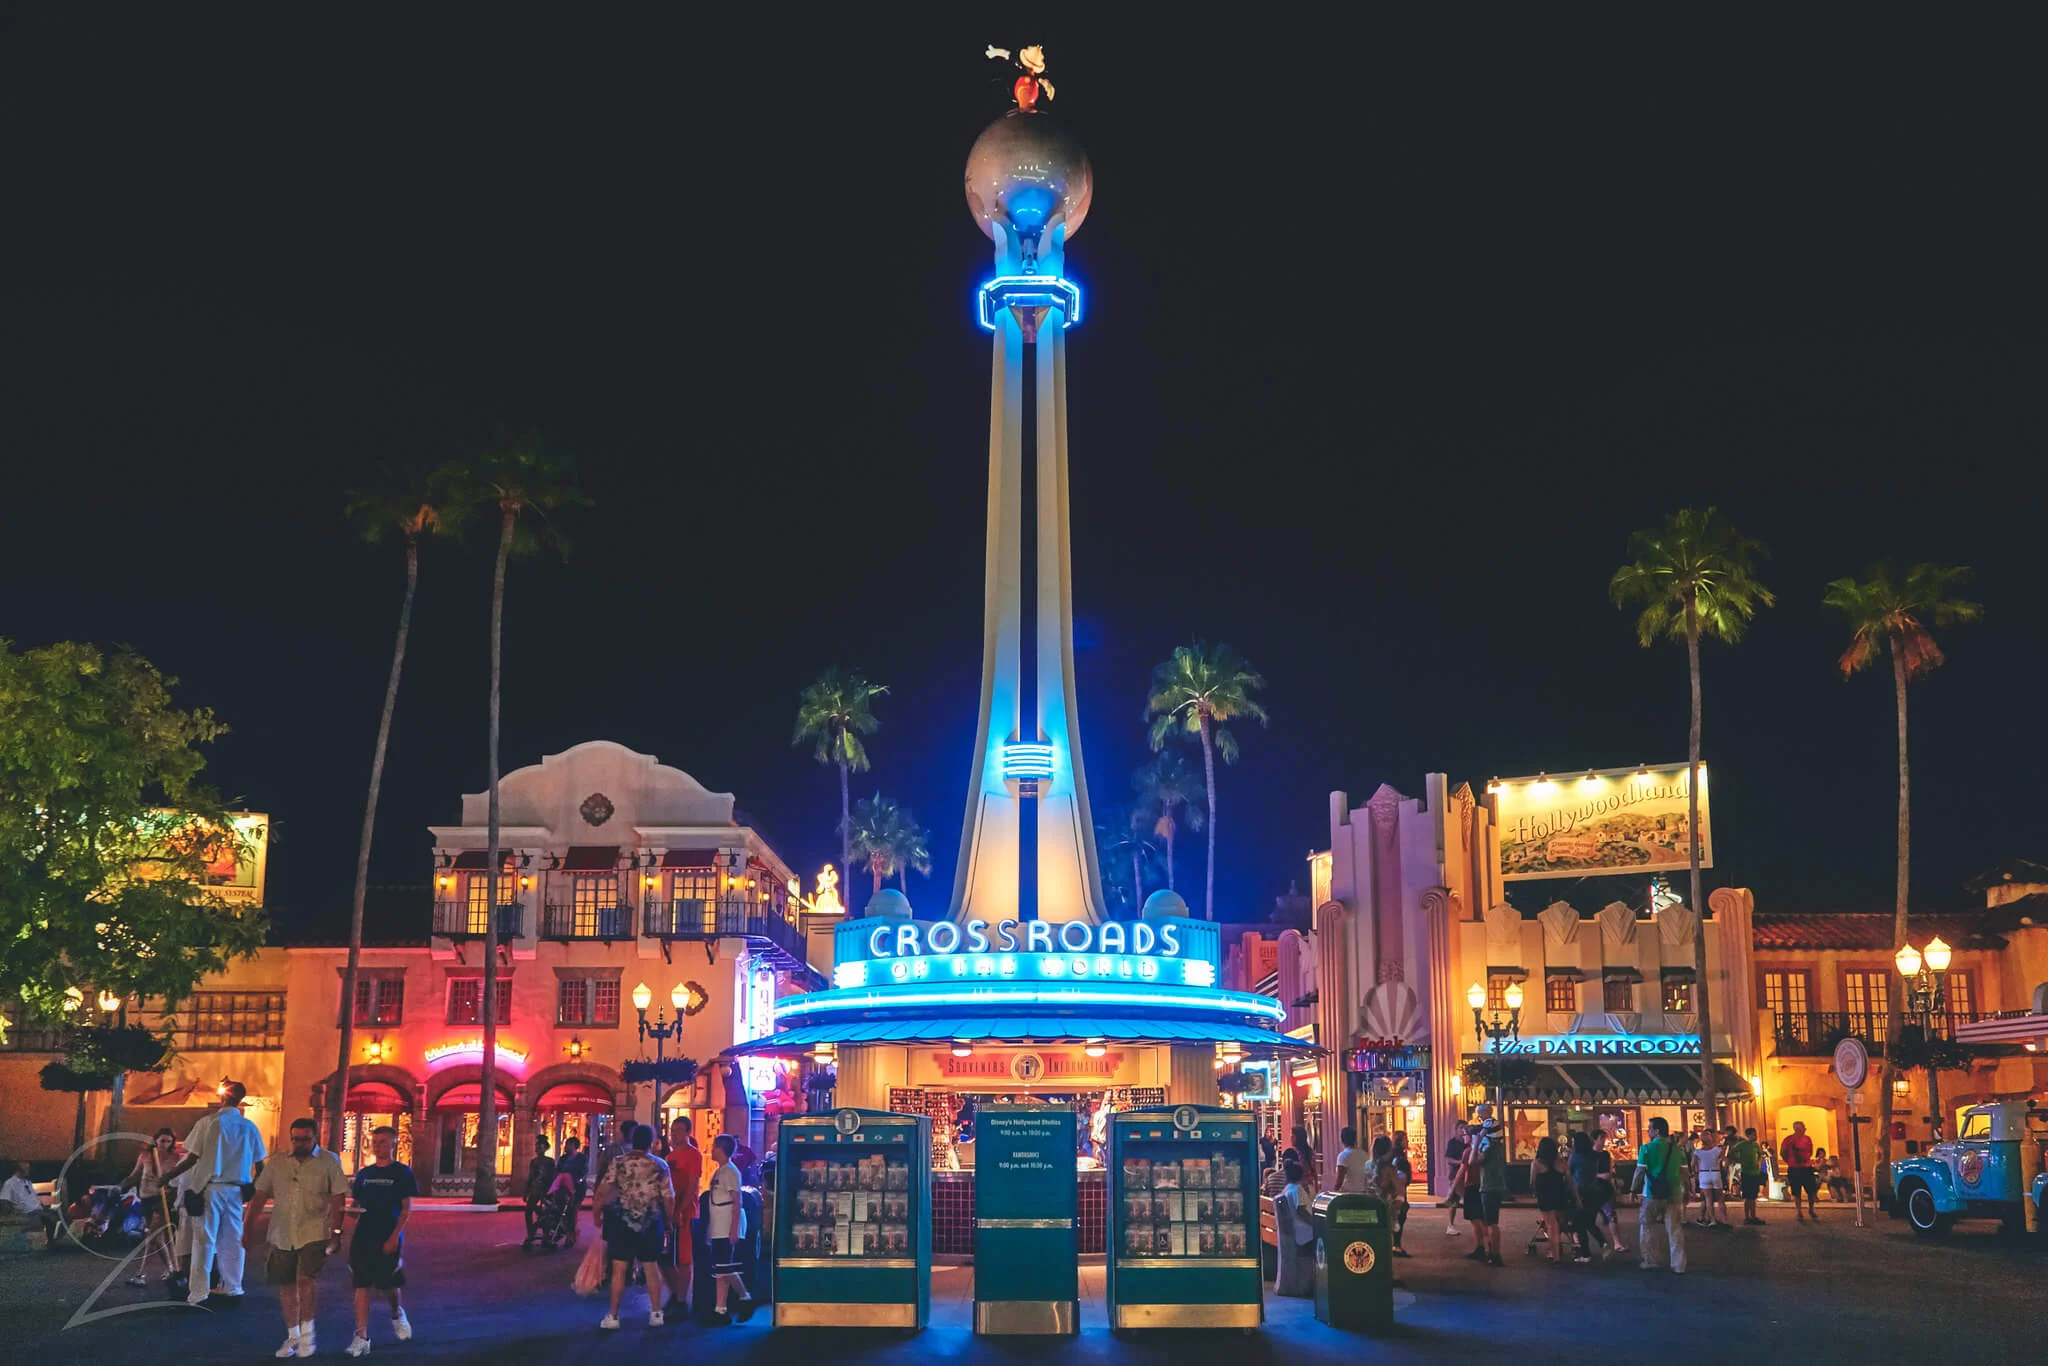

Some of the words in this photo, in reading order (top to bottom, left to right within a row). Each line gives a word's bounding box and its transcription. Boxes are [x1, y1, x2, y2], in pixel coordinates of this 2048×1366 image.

[1510, 776, 1689, 845] Hollywoodland
[870, 919, 1180, 957] CROSSROADS
[892, 959, 928, 978] OF
[953, 957, 1015, 977] THE
[1042, 957, 1156, 978] WORLD
[1359, 1035, 1404, 1049] Kodak
[1491, 1040, 1535, 1054] The
[1539, 1039, 1702, 1054] DARKROOM
